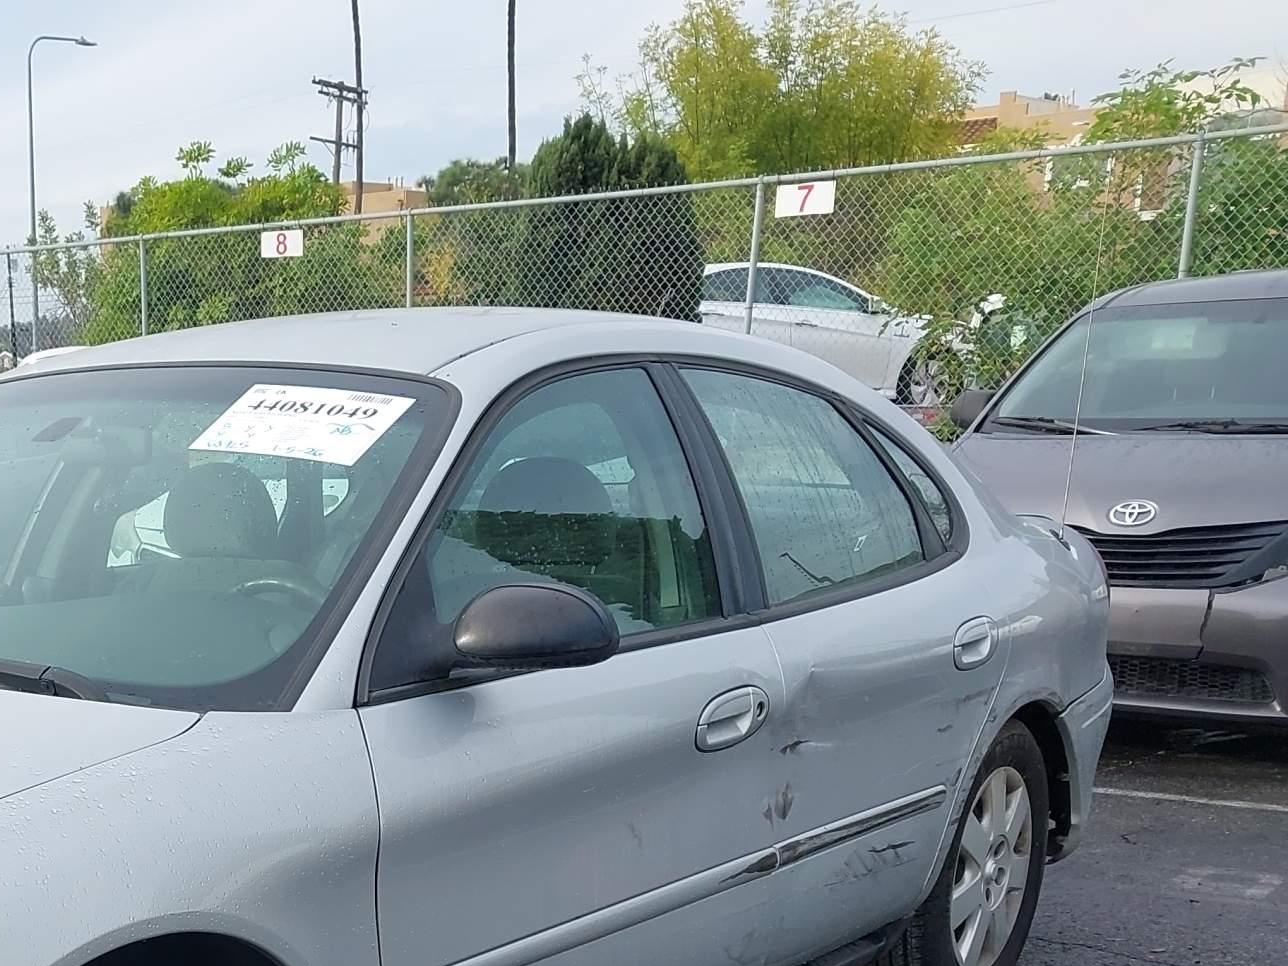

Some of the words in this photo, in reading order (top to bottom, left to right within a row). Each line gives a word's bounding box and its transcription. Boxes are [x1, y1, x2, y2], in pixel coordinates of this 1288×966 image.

[798, 184, 815, 213] 7
[276, 232, 288, 255] 8
[248, 399, 378, 420] 44081049
